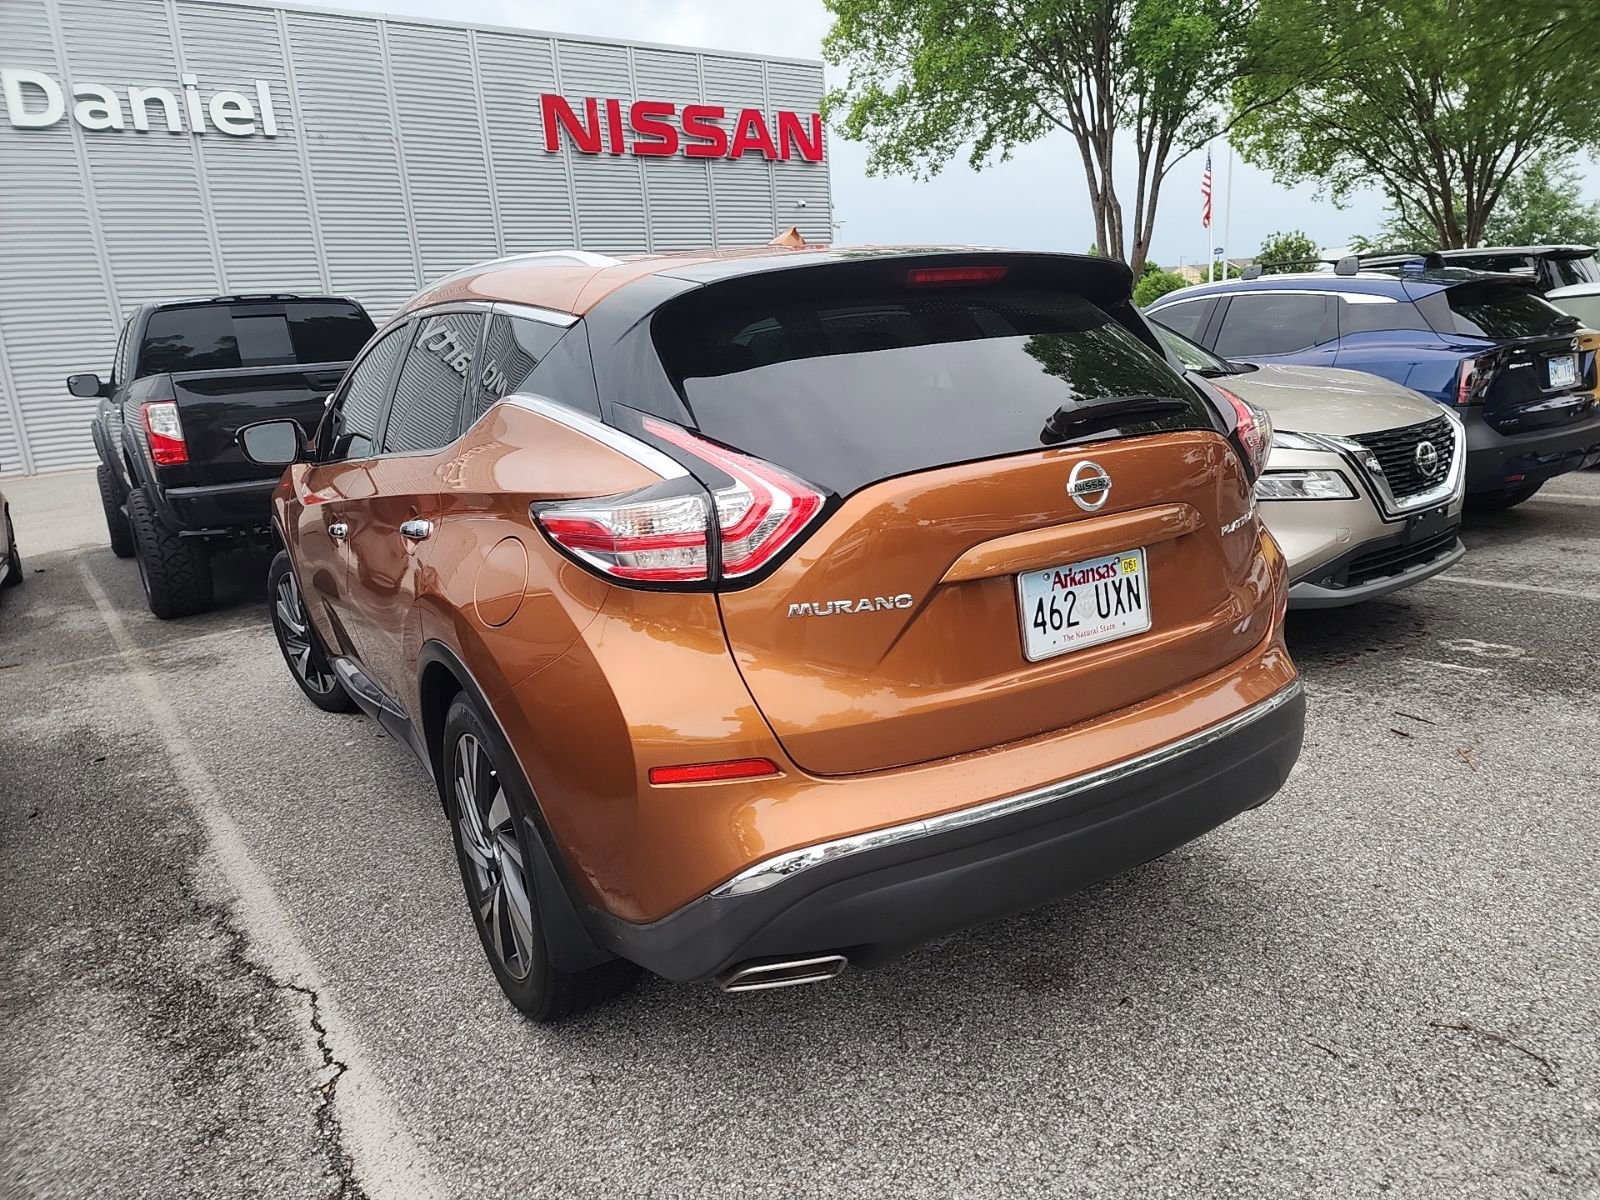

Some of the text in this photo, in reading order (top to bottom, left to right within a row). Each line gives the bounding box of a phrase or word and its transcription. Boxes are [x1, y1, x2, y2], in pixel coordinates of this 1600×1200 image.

[2, 69, 277, 136] Daniel
[540, 93, 824, 162] NISSAN
[1051, 562, 1118, 592] Arkansas
[787, 593, 913, 618] MURANO
[1033, 574, 1142, 635] 462 UXN
[1063, 623, 1116, 643] The Natural State
